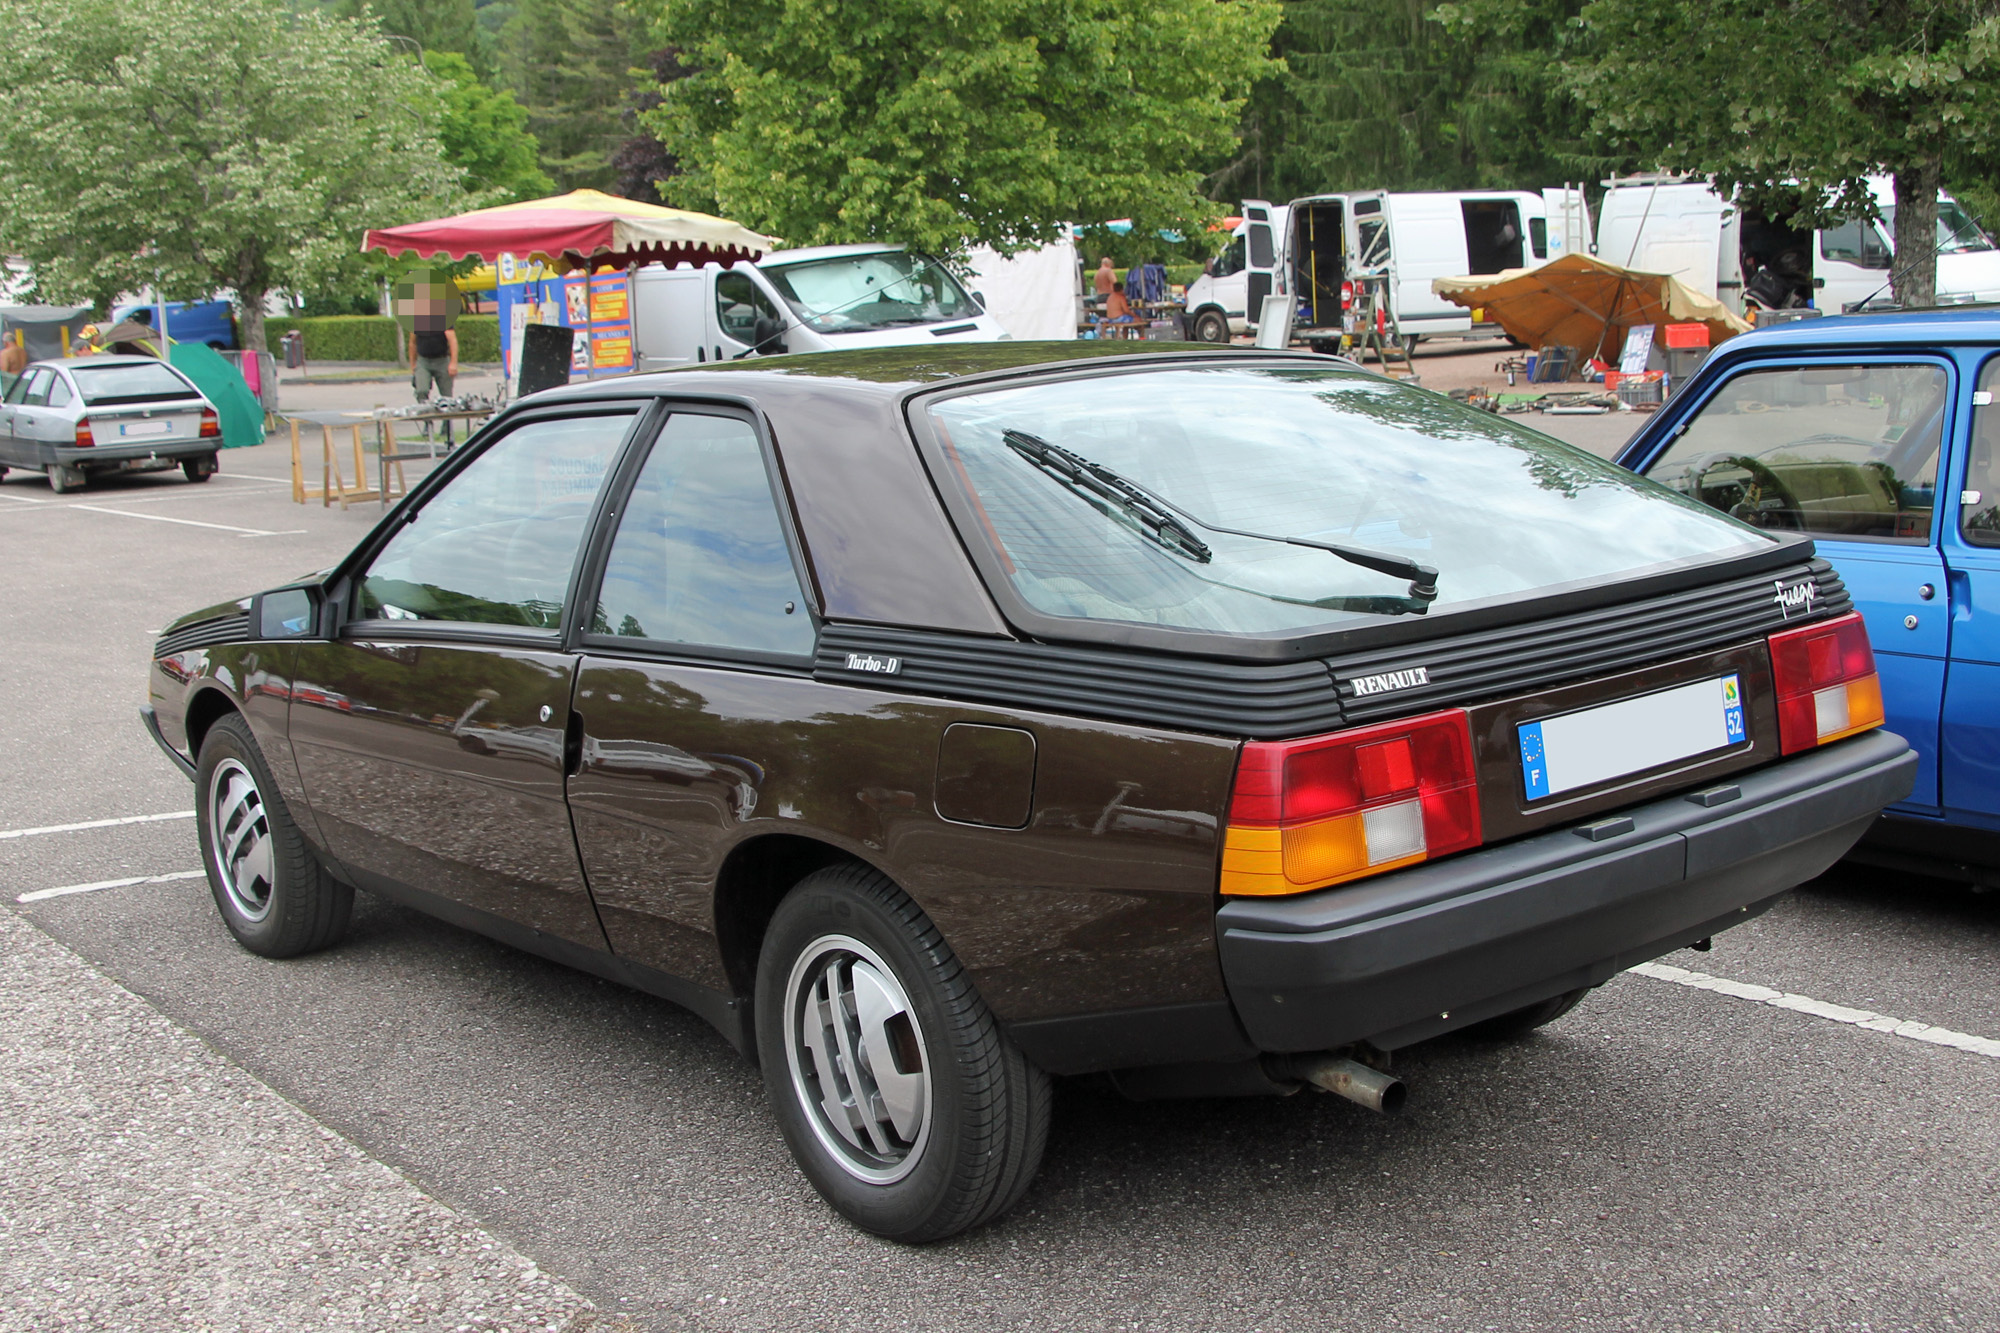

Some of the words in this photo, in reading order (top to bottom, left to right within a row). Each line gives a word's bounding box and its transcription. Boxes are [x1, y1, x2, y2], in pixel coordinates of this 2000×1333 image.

[847, 653, 898, 673] Turbo-D
[1351, 667, 1428, 696] RENAULT
[1727, 711, 1742, 735] 52
[1530, 769, 1540, 787] F
